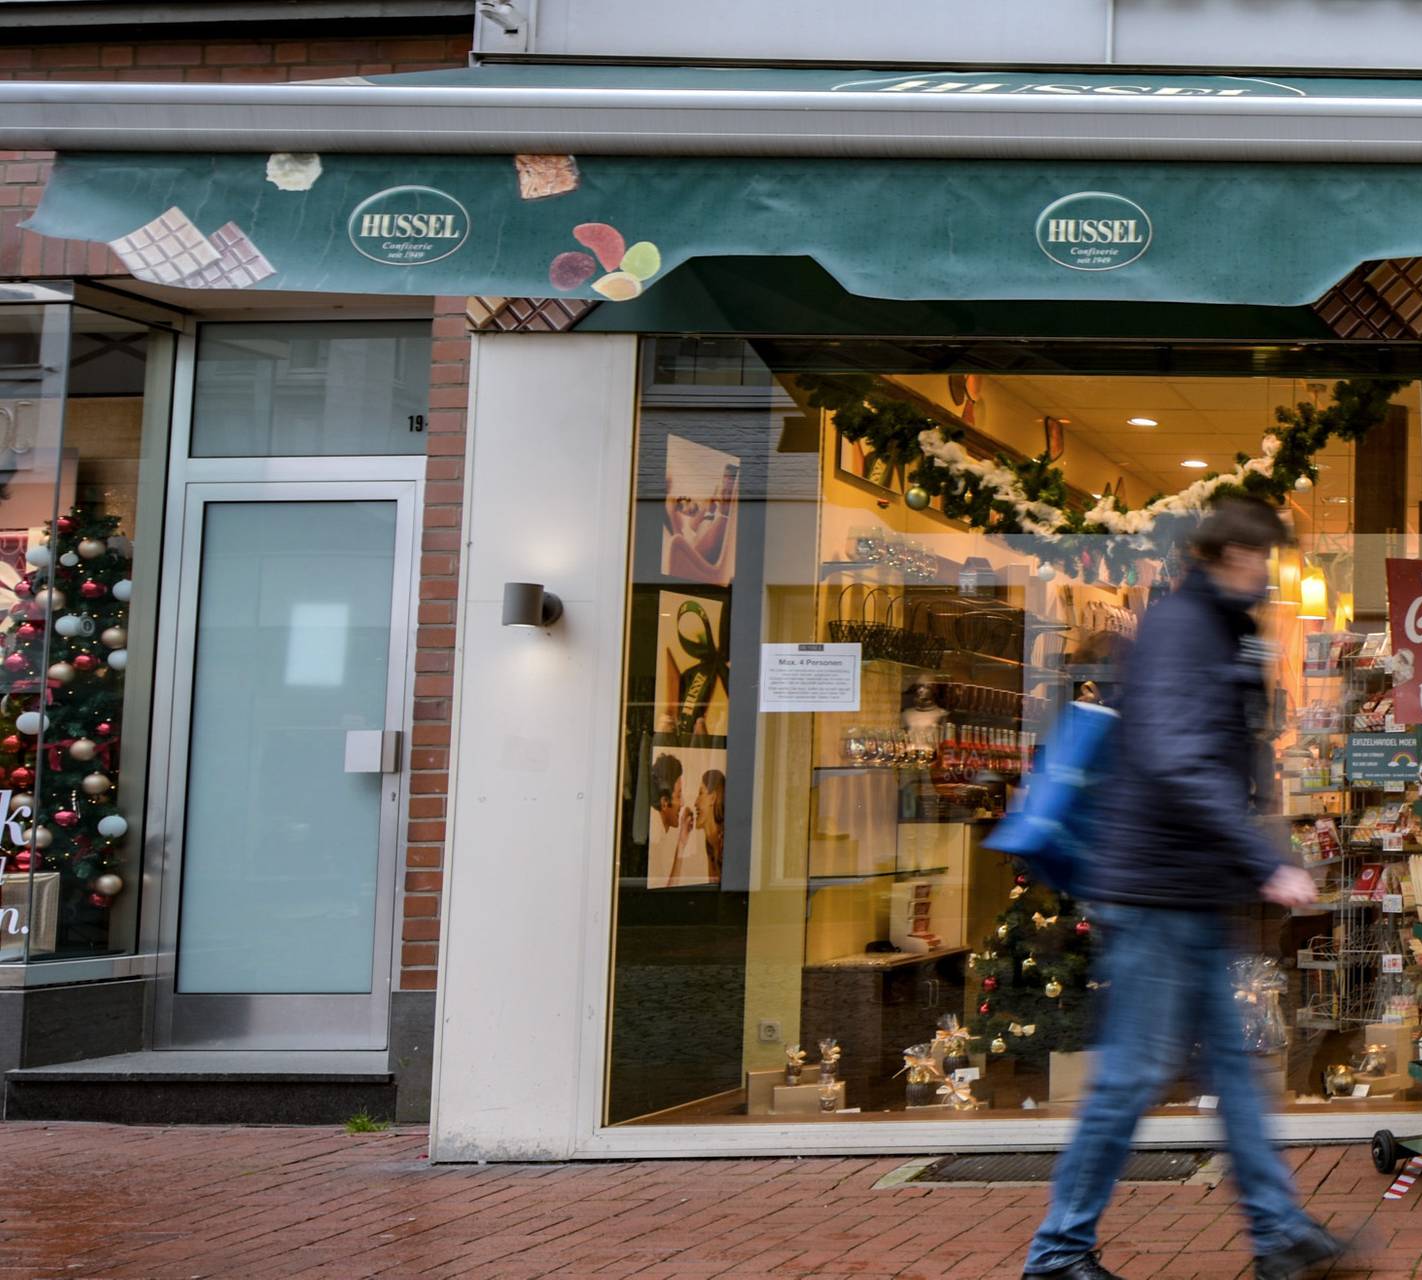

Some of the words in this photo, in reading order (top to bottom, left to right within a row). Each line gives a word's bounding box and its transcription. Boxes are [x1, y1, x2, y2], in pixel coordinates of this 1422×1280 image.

[360, 214, 460, 238] HUSSEL
[1048, 219, 1143, 243] HUSSEL
[382, 242, 433, 251] Confiserie
[1070, 247, 1119, 257] Confiserie
[1352, 738, 1397, 746] EINZELHANDEL
[1399, 738, 1417, 746] MOER
